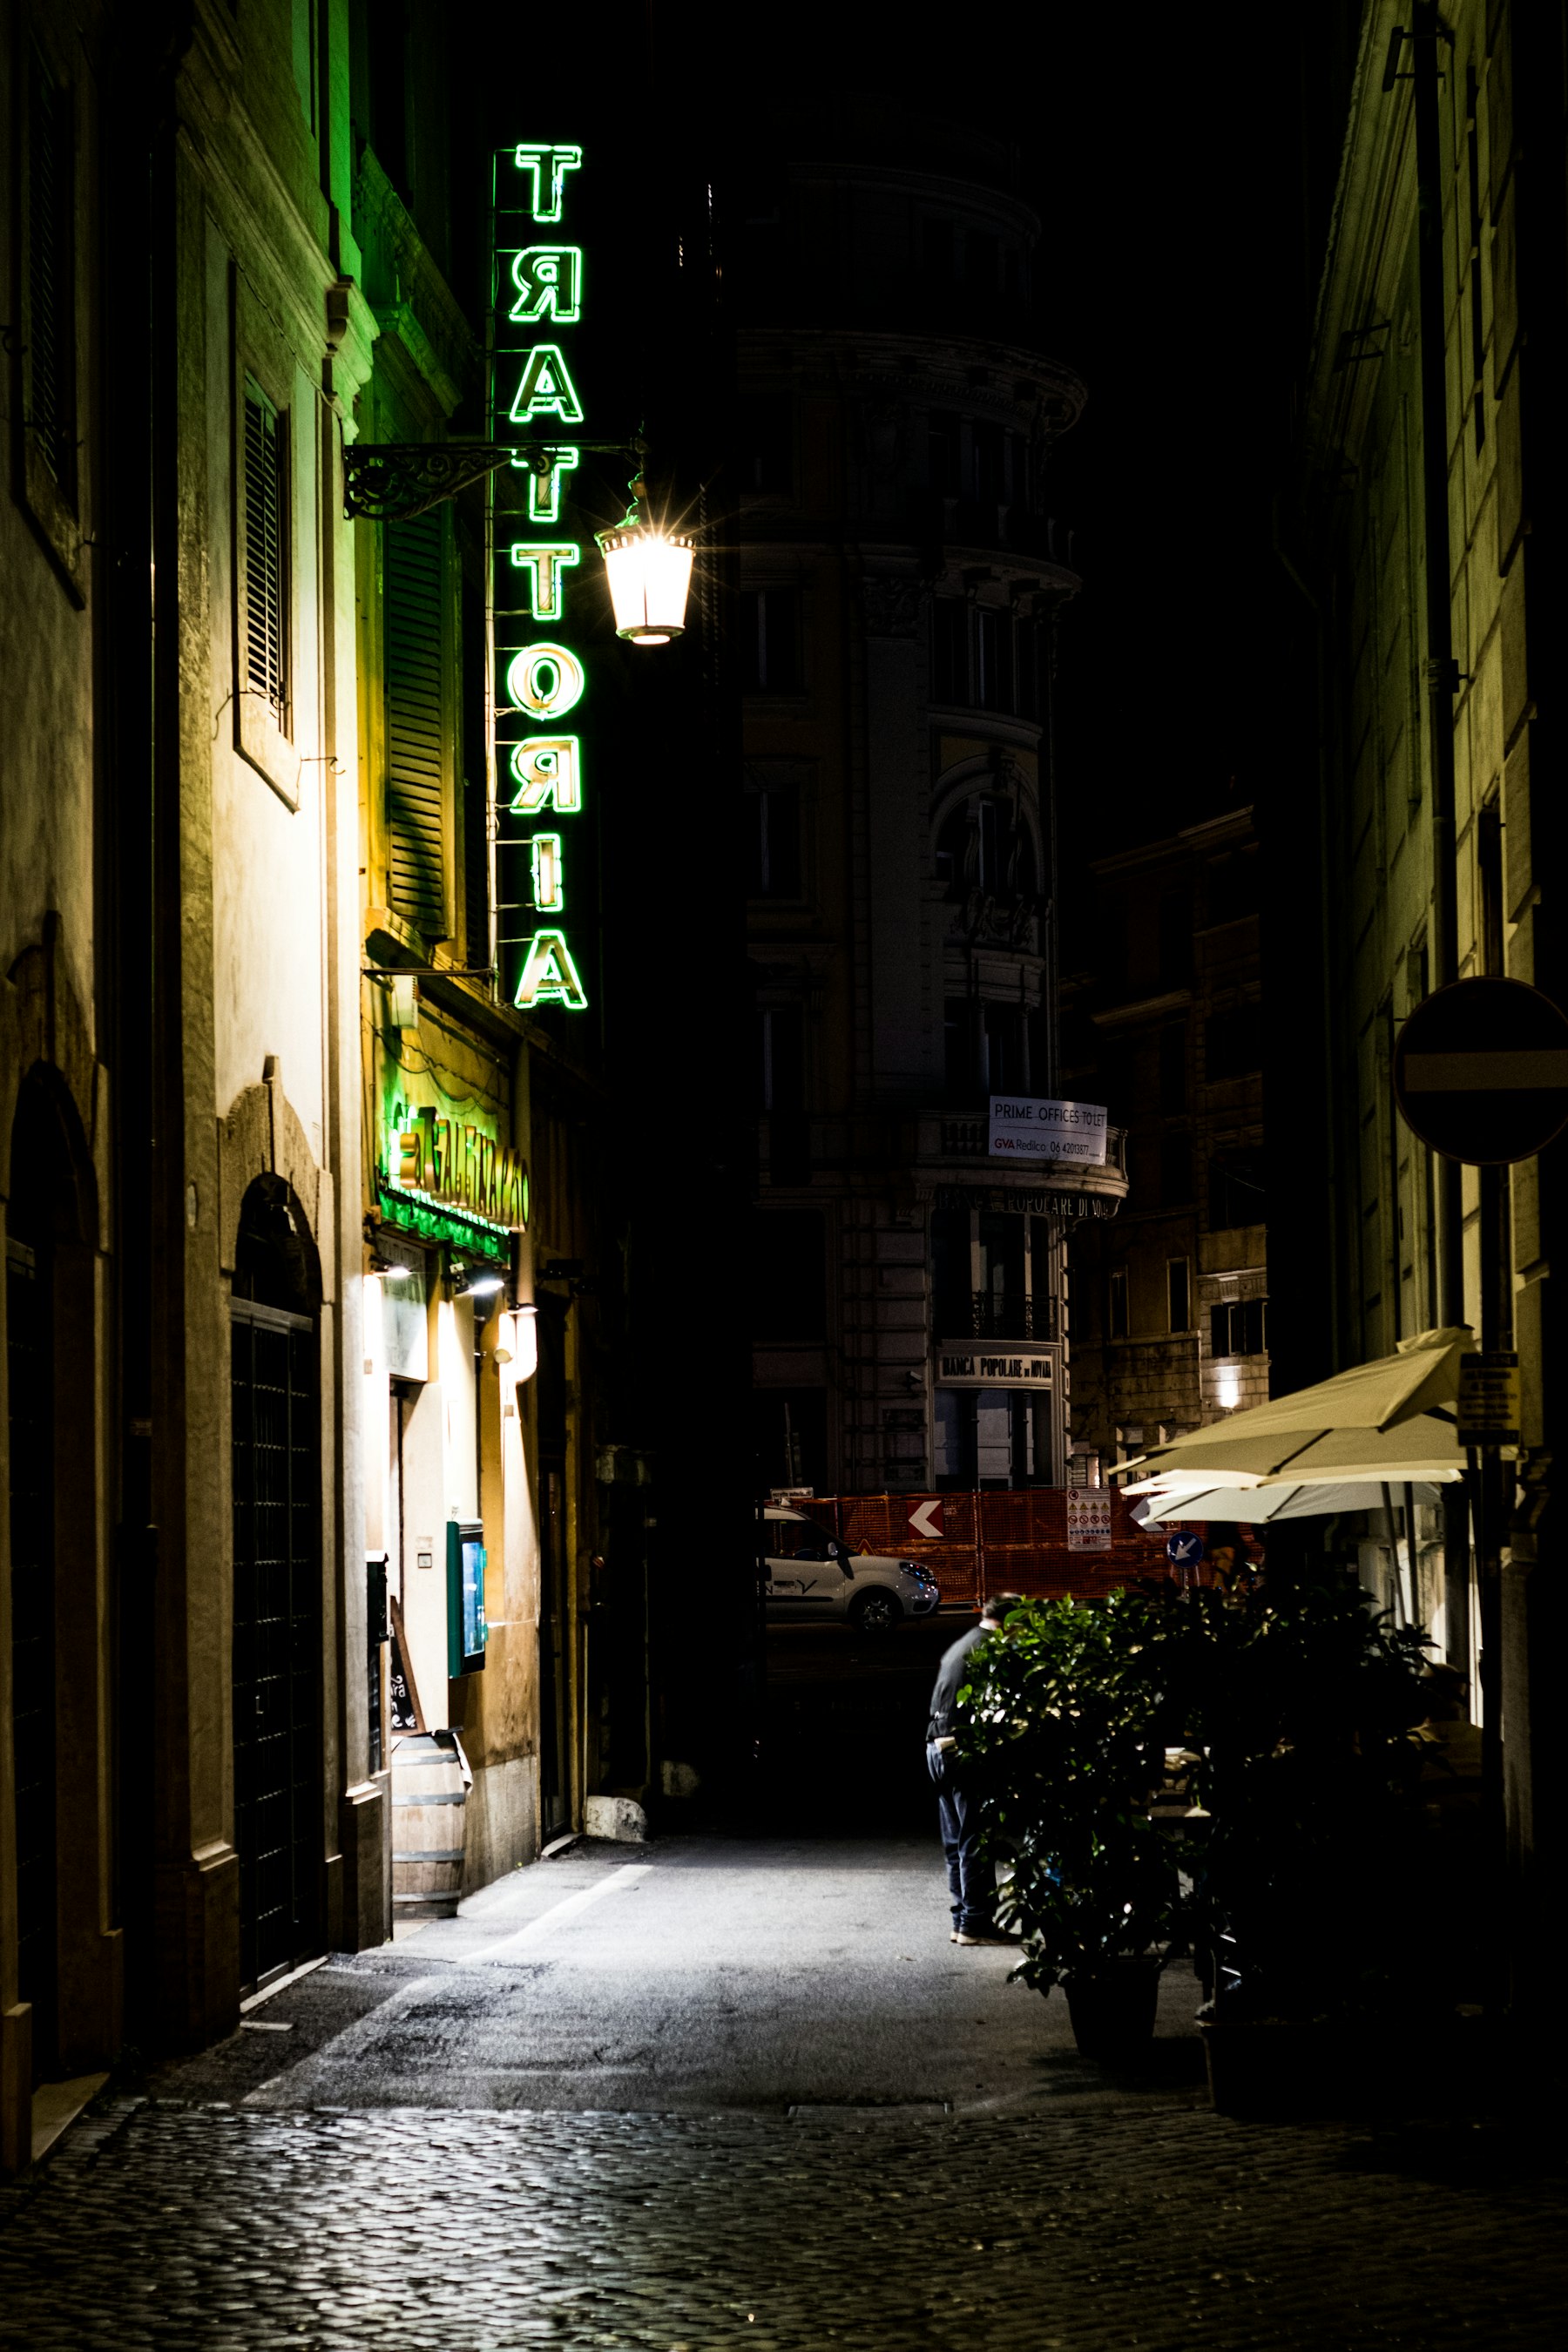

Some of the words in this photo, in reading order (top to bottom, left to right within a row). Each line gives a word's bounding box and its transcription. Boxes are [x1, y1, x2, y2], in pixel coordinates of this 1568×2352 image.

[995, 1104, 1033, 1119] PRIME
[1038, 1106, 1079, 1124] OFFICES
[1083, 1112, 1092, 1125] TO
[1093, 1113, 1105, 1127] LET
[994, 1138, 1015, 1150] GVA
[1016, 1139, 1046, 1152] Redilco
[1050, 1141, 1061, 1152] 06
[1007, 1192, 1073, 1217] POPOLARE
[1078, 1198, 1088, 1217] DI
[943, 1356, 975, 1376] BANCA
[980, 1357, 1023, 1378] POPOLARE
